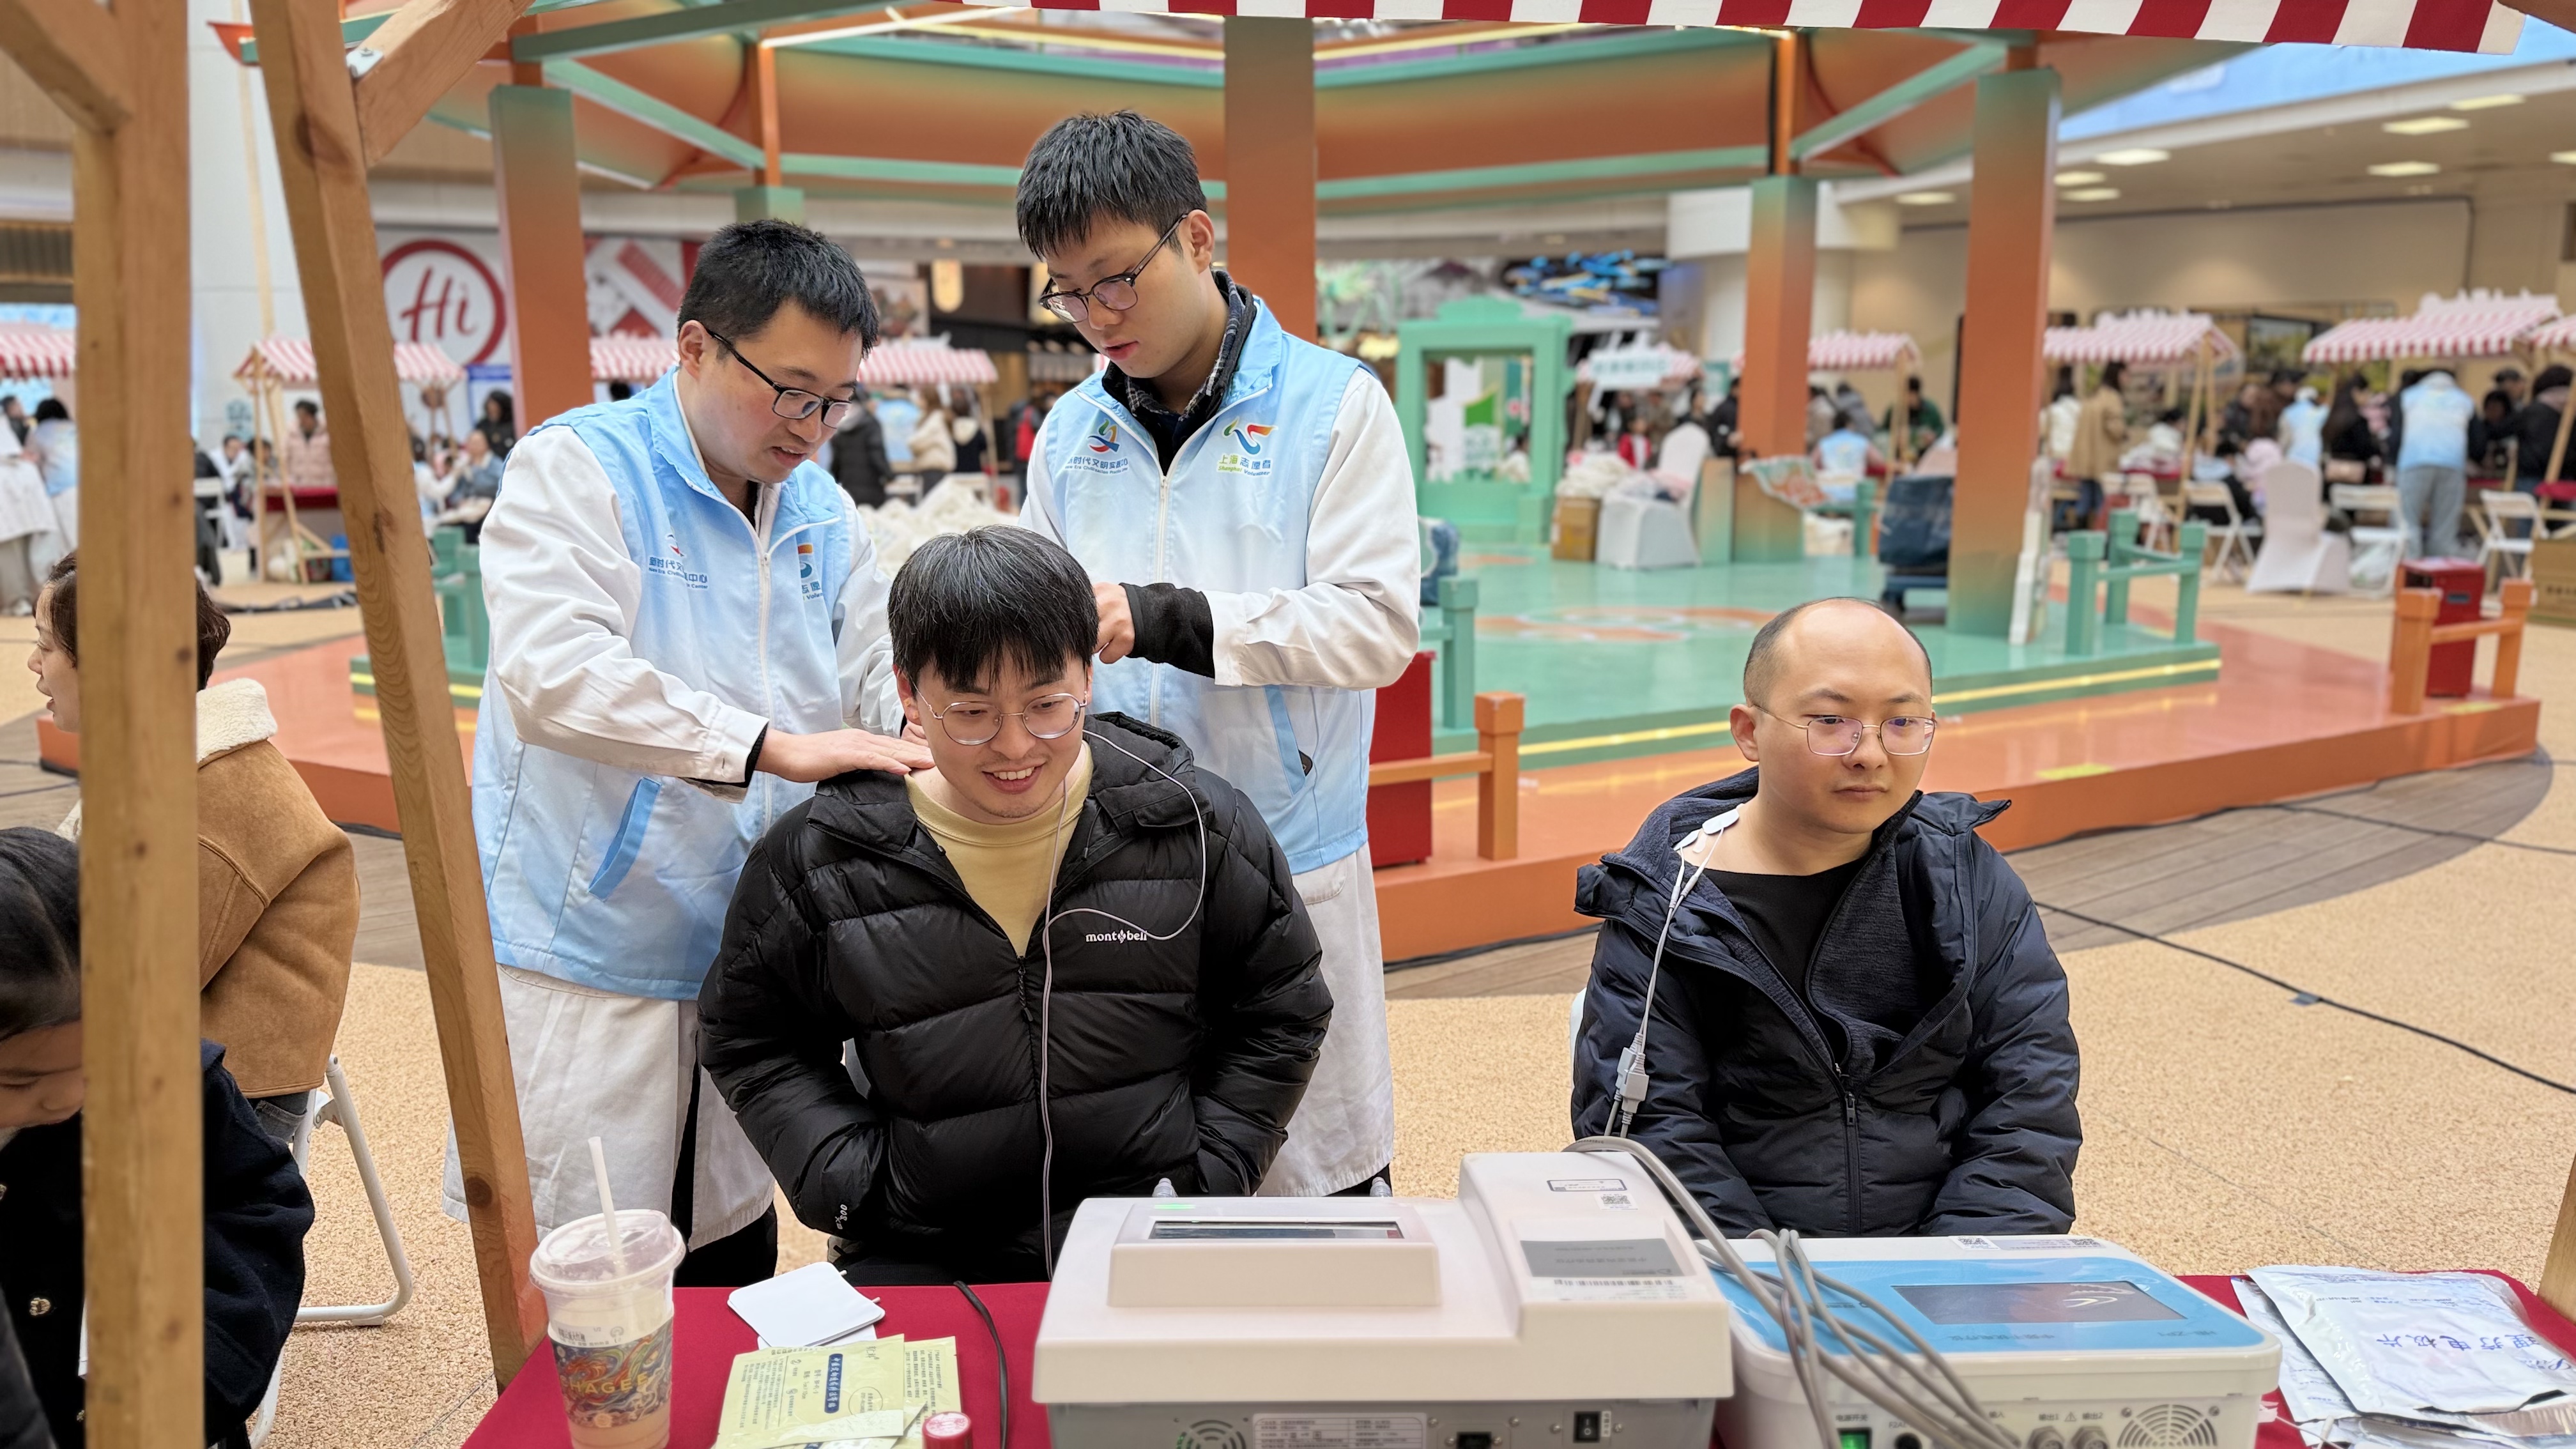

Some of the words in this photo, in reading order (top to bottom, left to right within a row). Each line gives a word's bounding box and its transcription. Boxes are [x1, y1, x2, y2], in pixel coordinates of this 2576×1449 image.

[401, 265, 479, 342] Hi
[2376, 1333, 2541, 1351] 理疗电极片
[1836, 1414, 1868, 1422] 电源开关
